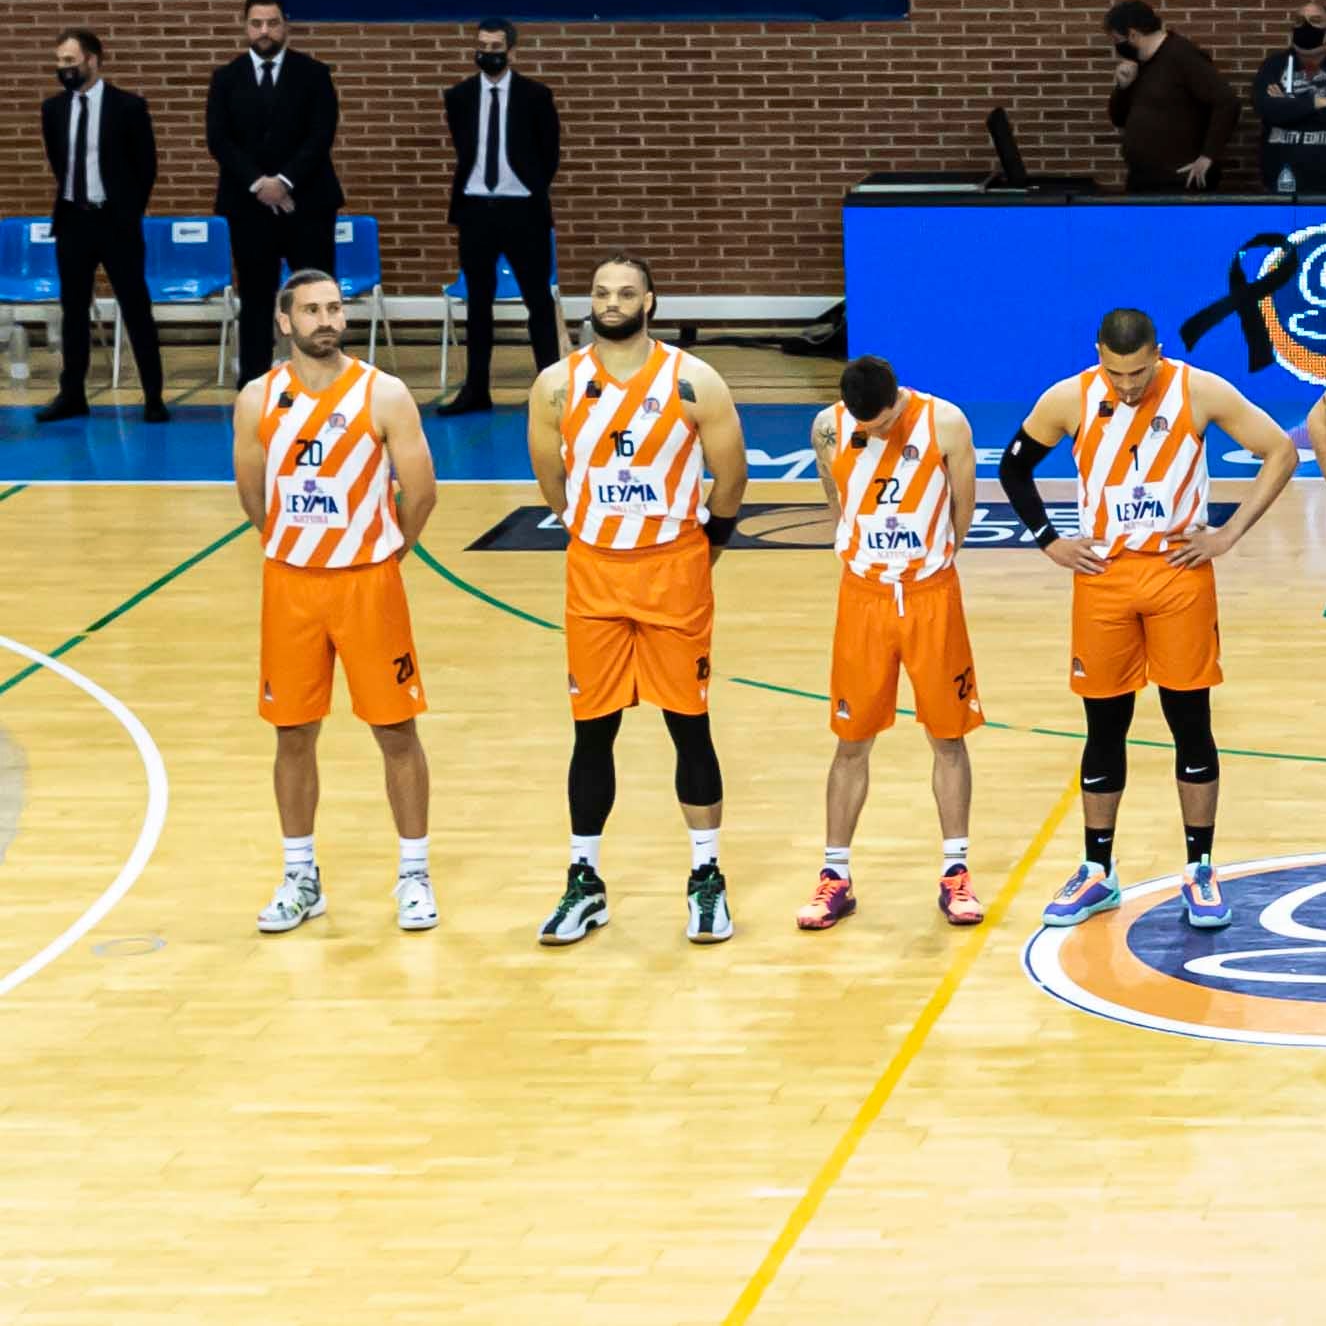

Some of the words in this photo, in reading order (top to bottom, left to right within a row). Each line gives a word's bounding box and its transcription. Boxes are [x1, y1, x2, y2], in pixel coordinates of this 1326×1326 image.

[295, 439, 323, 466] 20
[609, 430, 634, 457] 16
[1127, 444, 1140, 471] 1
[598, 484, 658, 504] LEYMA
[874, 477, 904, 505] 22
[286, 494, 339, 514] LEYMA
[1116, 501, 1166, 522] LEYMA
[867, 530, 922, 550] LEYMA
